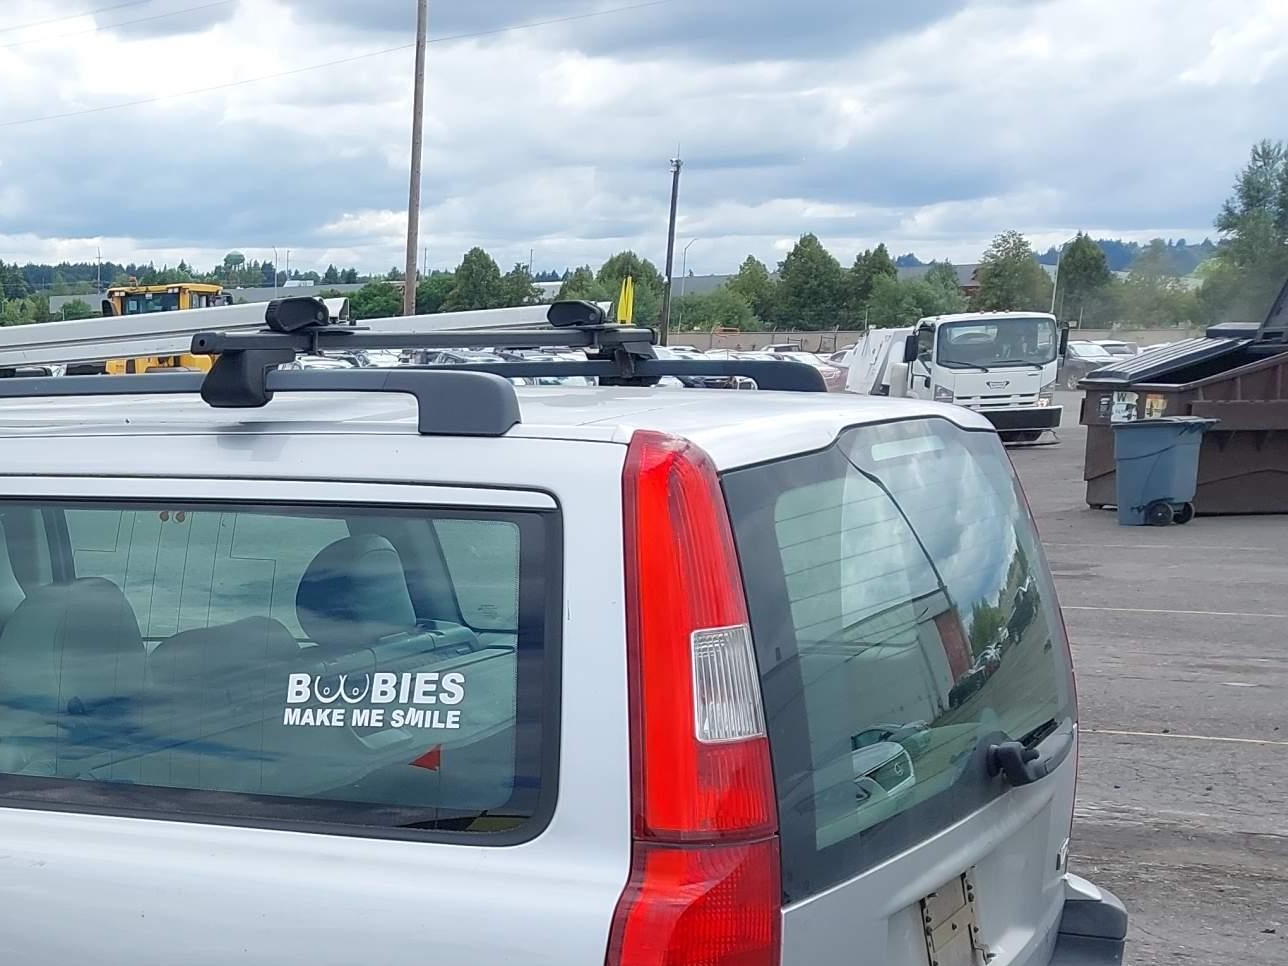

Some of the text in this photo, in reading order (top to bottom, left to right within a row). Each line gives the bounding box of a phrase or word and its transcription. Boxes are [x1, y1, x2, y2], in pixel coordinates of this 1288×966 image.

[283, 707, 462, 729] MAKE ME SMILE
